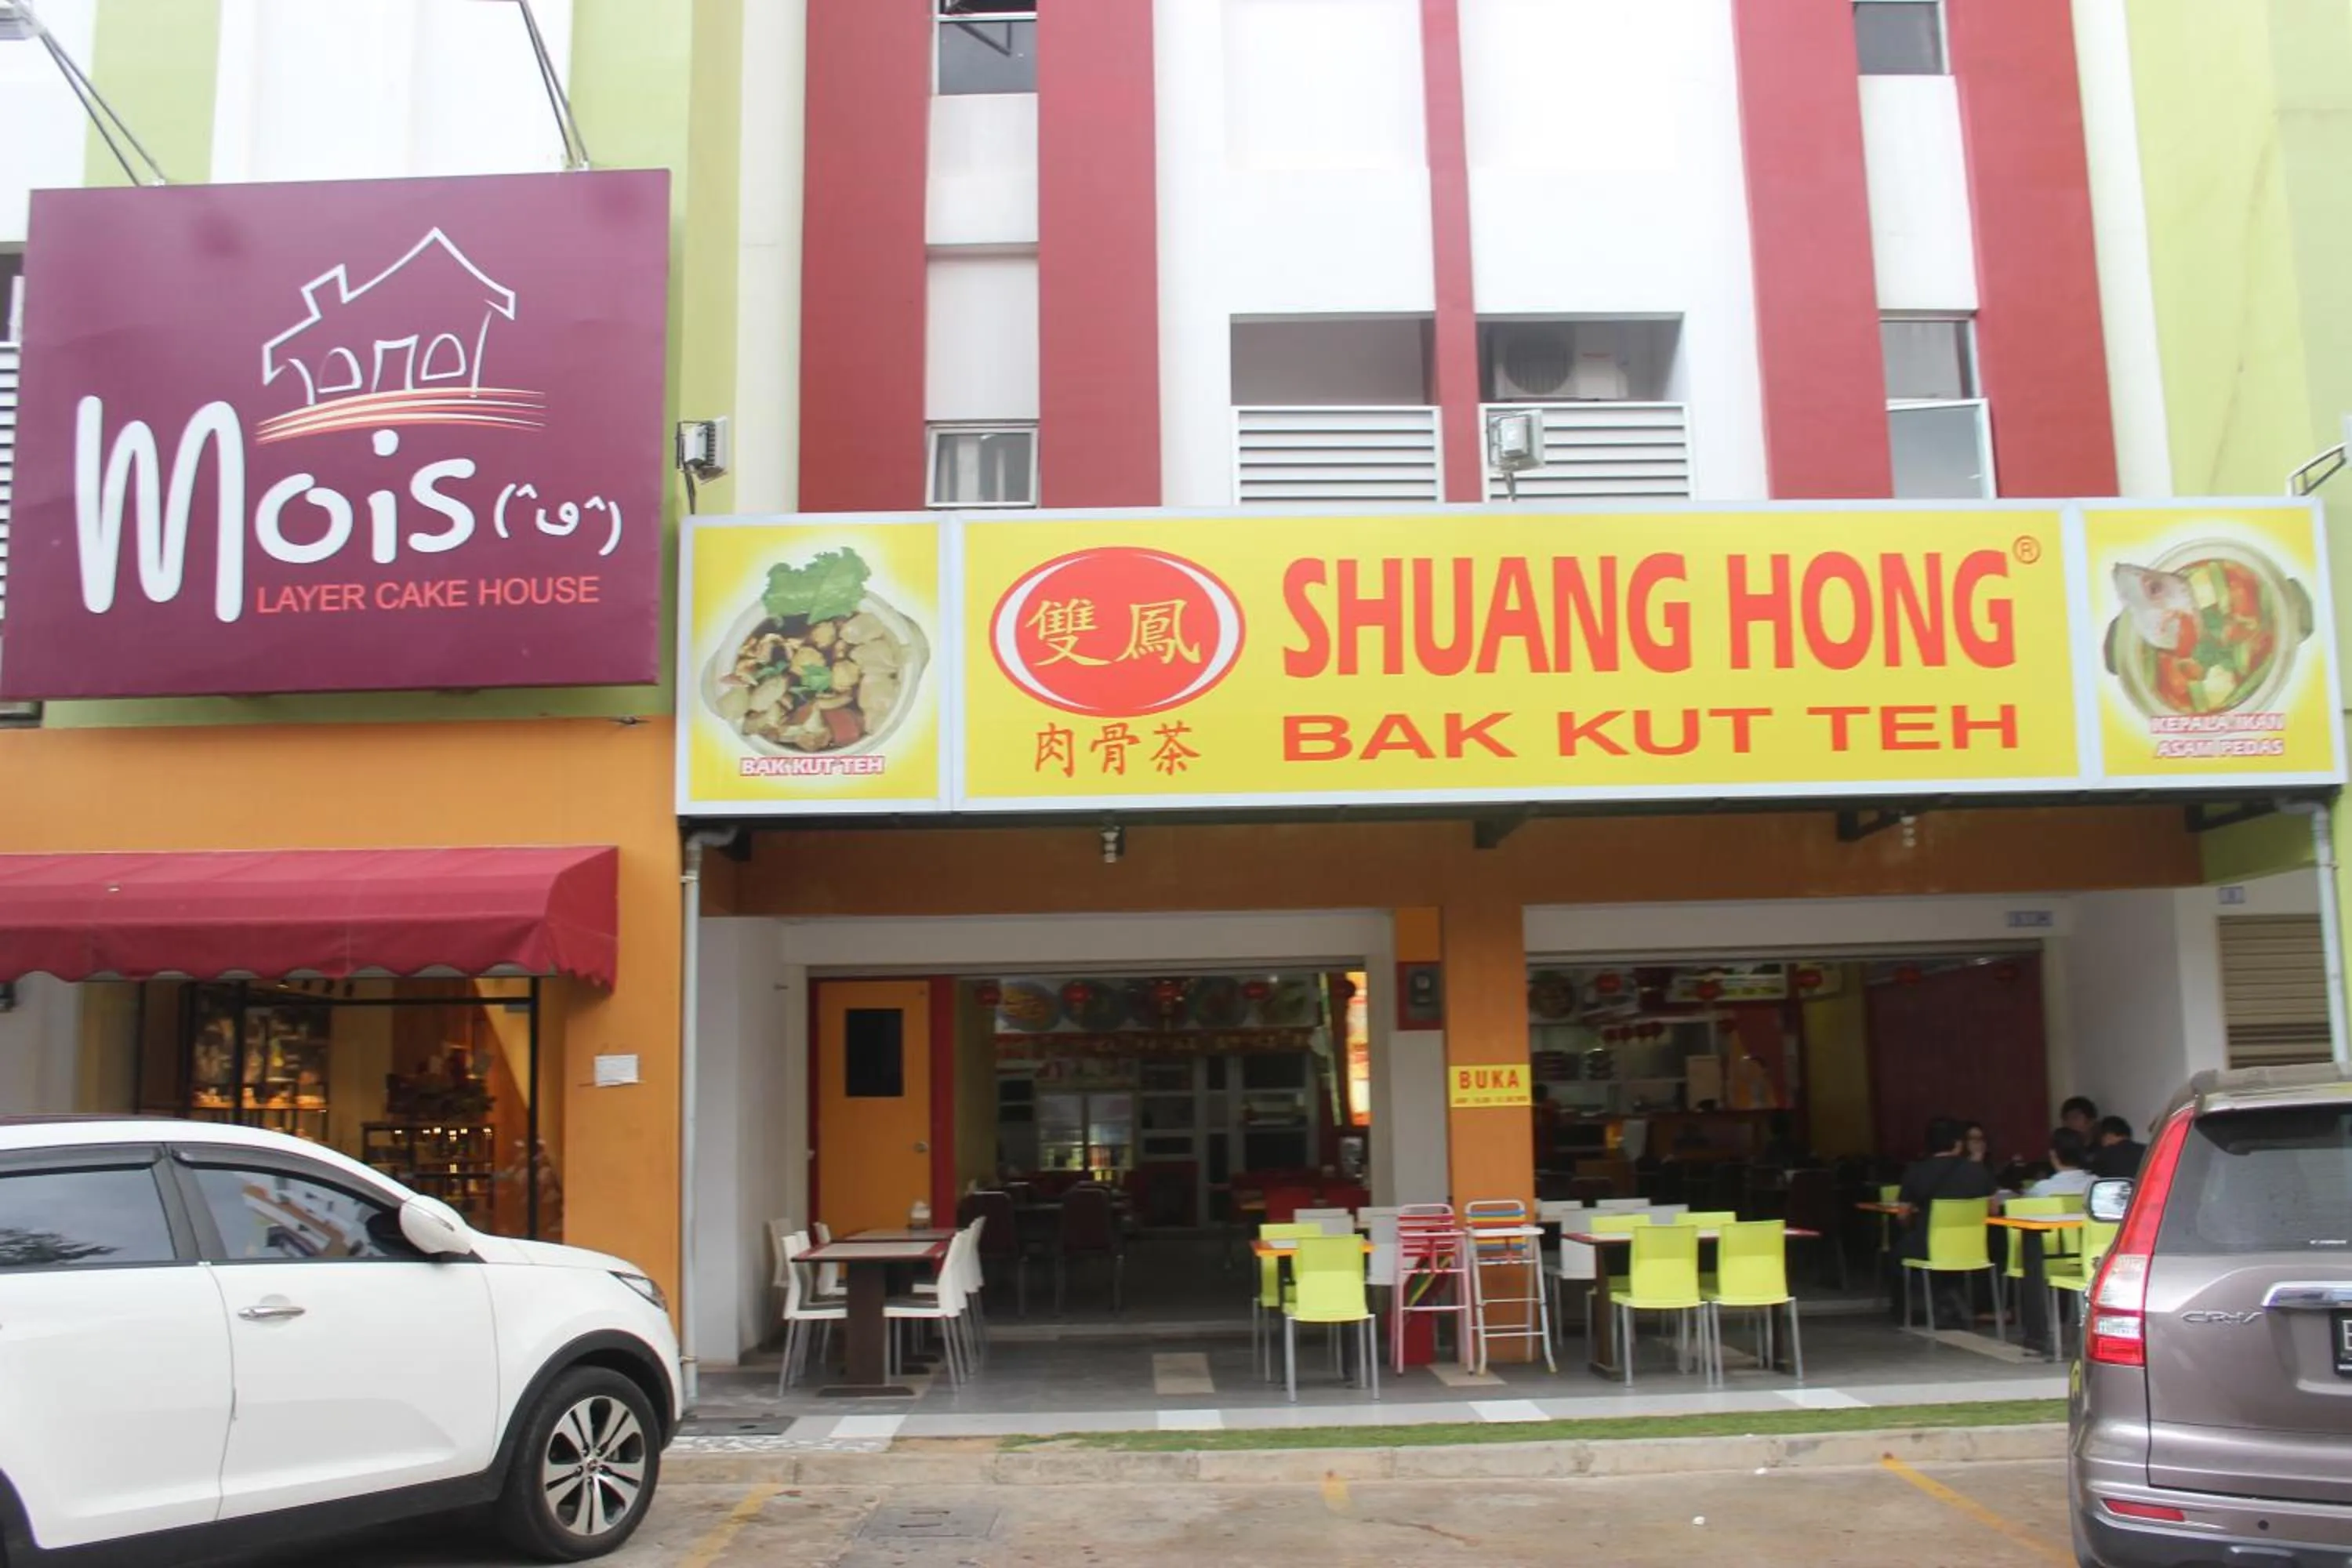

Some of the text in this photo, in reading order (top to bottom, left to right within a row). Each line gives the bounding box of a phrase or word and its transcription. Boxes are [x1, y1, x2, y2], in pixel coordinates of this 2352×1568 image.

[257, 575, 600, 613] LAYER CAKE HOUSE
[1283, 552, 1692, 679] SHUANG
[1726, 549, 2017, 670] HONG
[1025, 598, 1202, 666] 雙鳳
[1034, 719, 1201, 779] 肉骨茶
[1283, 703, 2018, 762] BAK KUT TEH
[2155, 738, 2284, 757] ASAM PEDAS
[741, 756, 884, 775] BAK KUT TEH
[1459, 1069, 1519, 1090] BUKA
